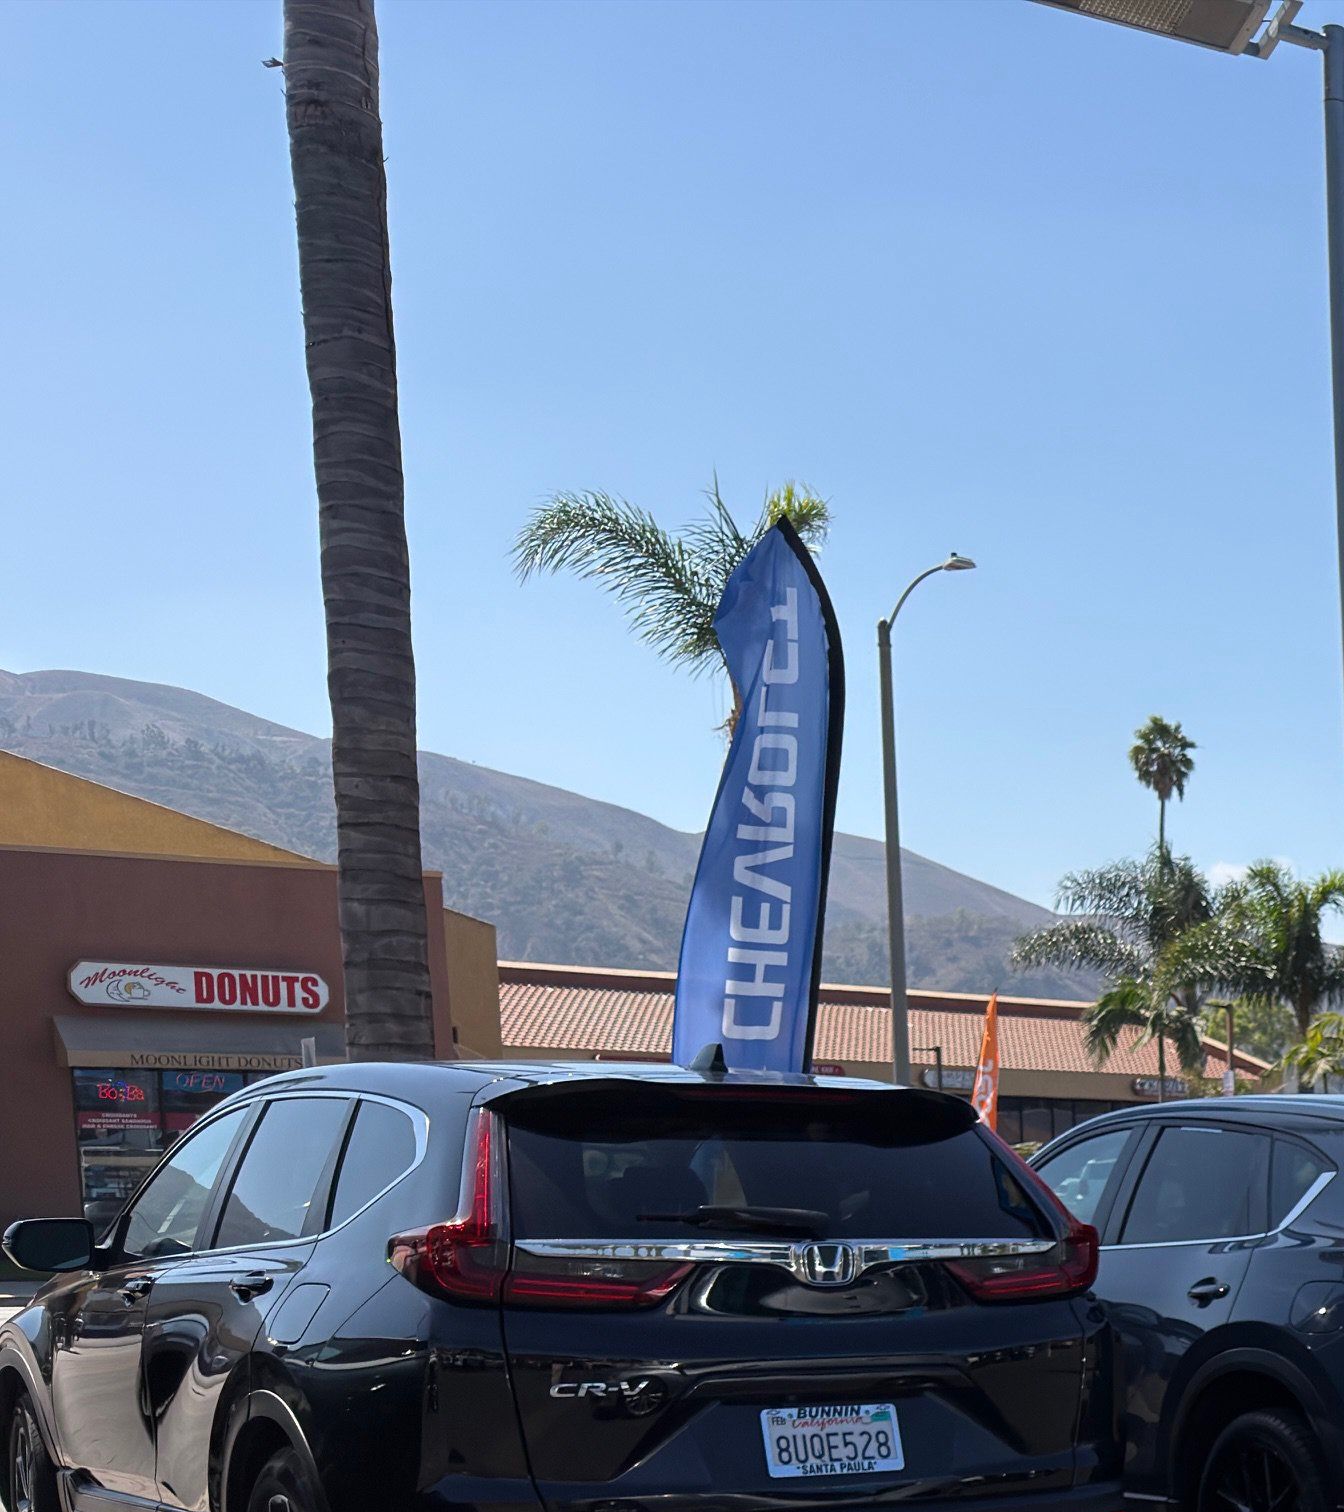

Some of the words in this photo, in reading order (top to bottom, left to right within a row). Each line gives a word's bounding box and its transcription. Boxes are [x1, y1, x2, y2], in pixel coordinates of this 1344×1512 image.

[79, 967, 187, 994] Moonlight
[193, 971, 321, 1010] DONUTS
[130, 1053, 234, 1068] MOONLIGHT
[237, 1056, 303, 1069] DONUTS
[549, 1380, 650, 1398] CR-V
[797, 1405, 861, 1419] BUNNIN
